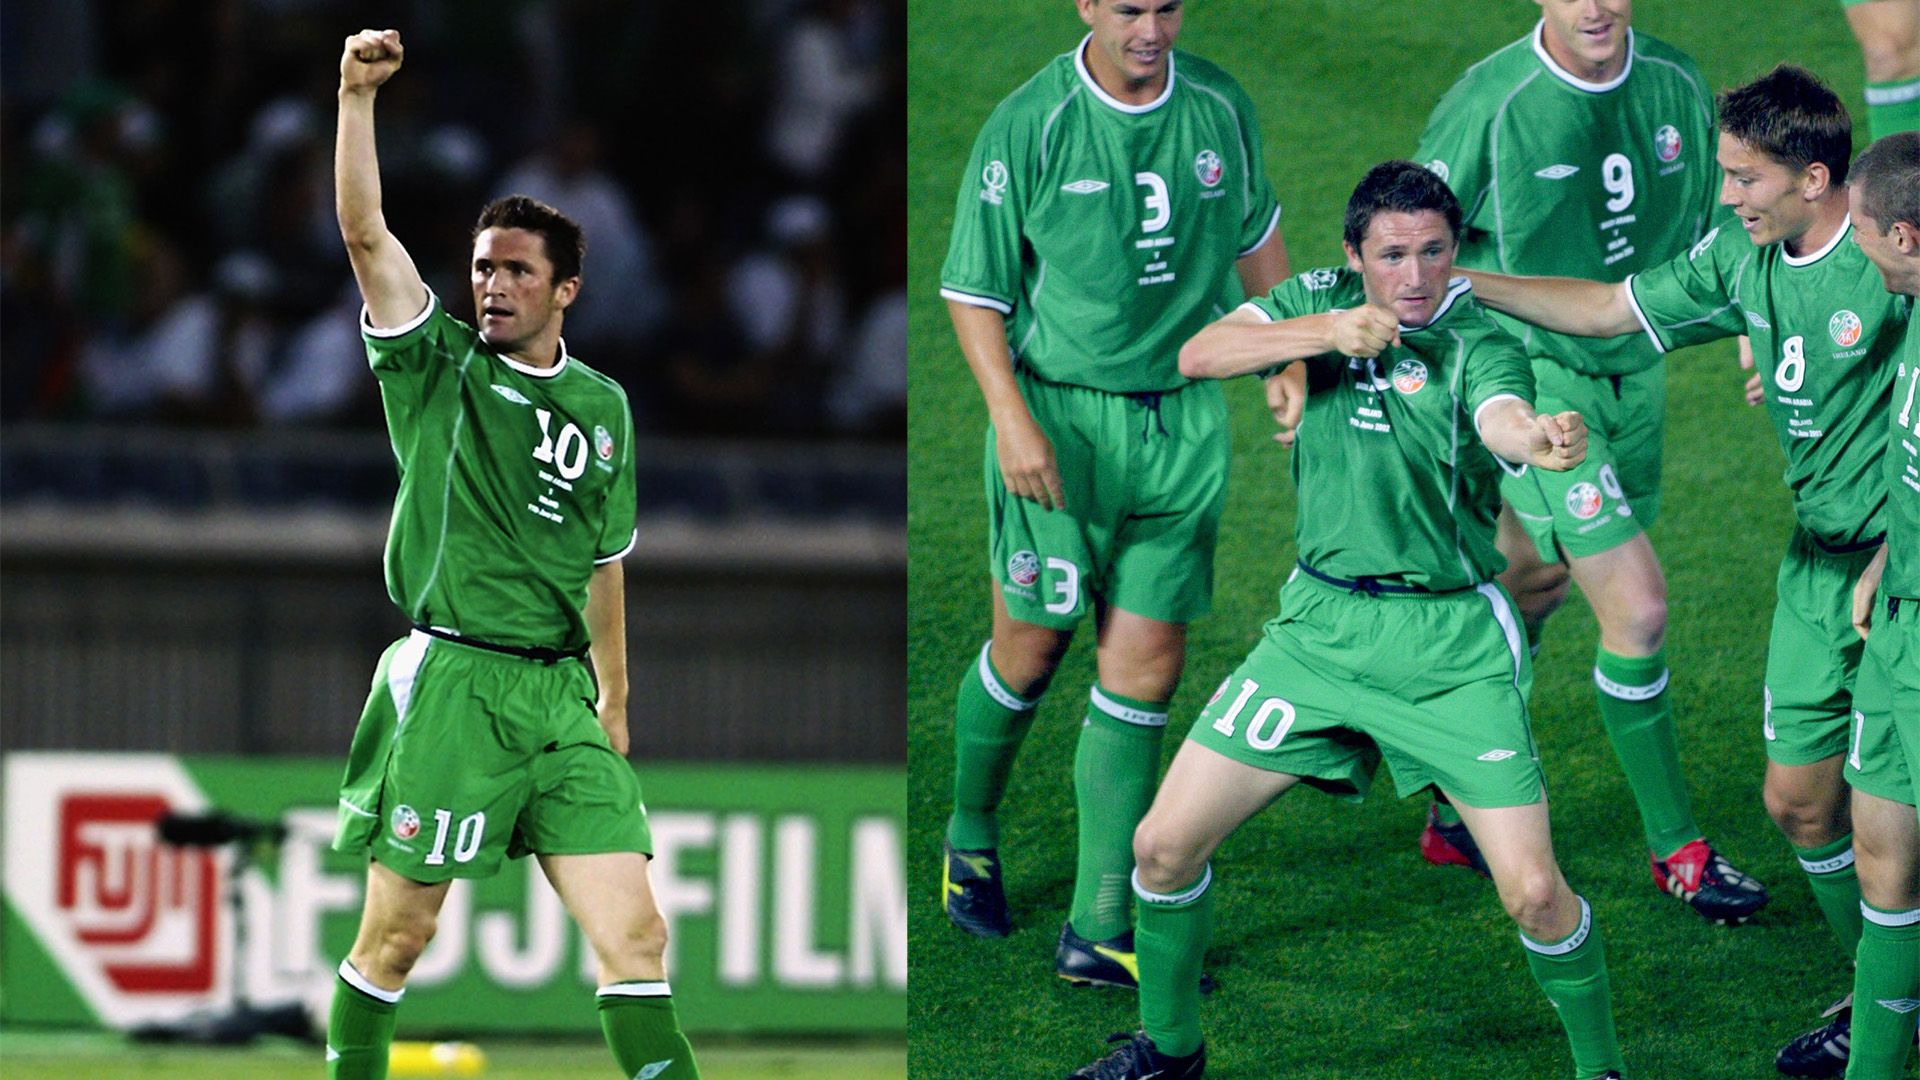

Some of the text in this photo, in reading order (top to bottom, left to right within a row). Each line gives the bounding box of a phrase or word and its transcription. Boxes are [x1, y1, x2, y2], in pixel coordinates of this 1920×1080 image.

[1135, 171, 1171, 233] 3
[1602, 153, 1635, 213] 9
[1775, 335, 1805, 392] 8
[1832, 348, 1867, 359] IRELAND
[1898, 366, 1920, 438] 1
[532, 408, 589, 480] 10
[1599, 463, 1632, 518] 9
[1045, 557, 1079, 615] 3
[1212, 678, 1296, 750] 10
[424, 808, 485, 865] 10
[57, 793, 216, 994] FUJI
[283, 806, 908, 992] FJFILM
